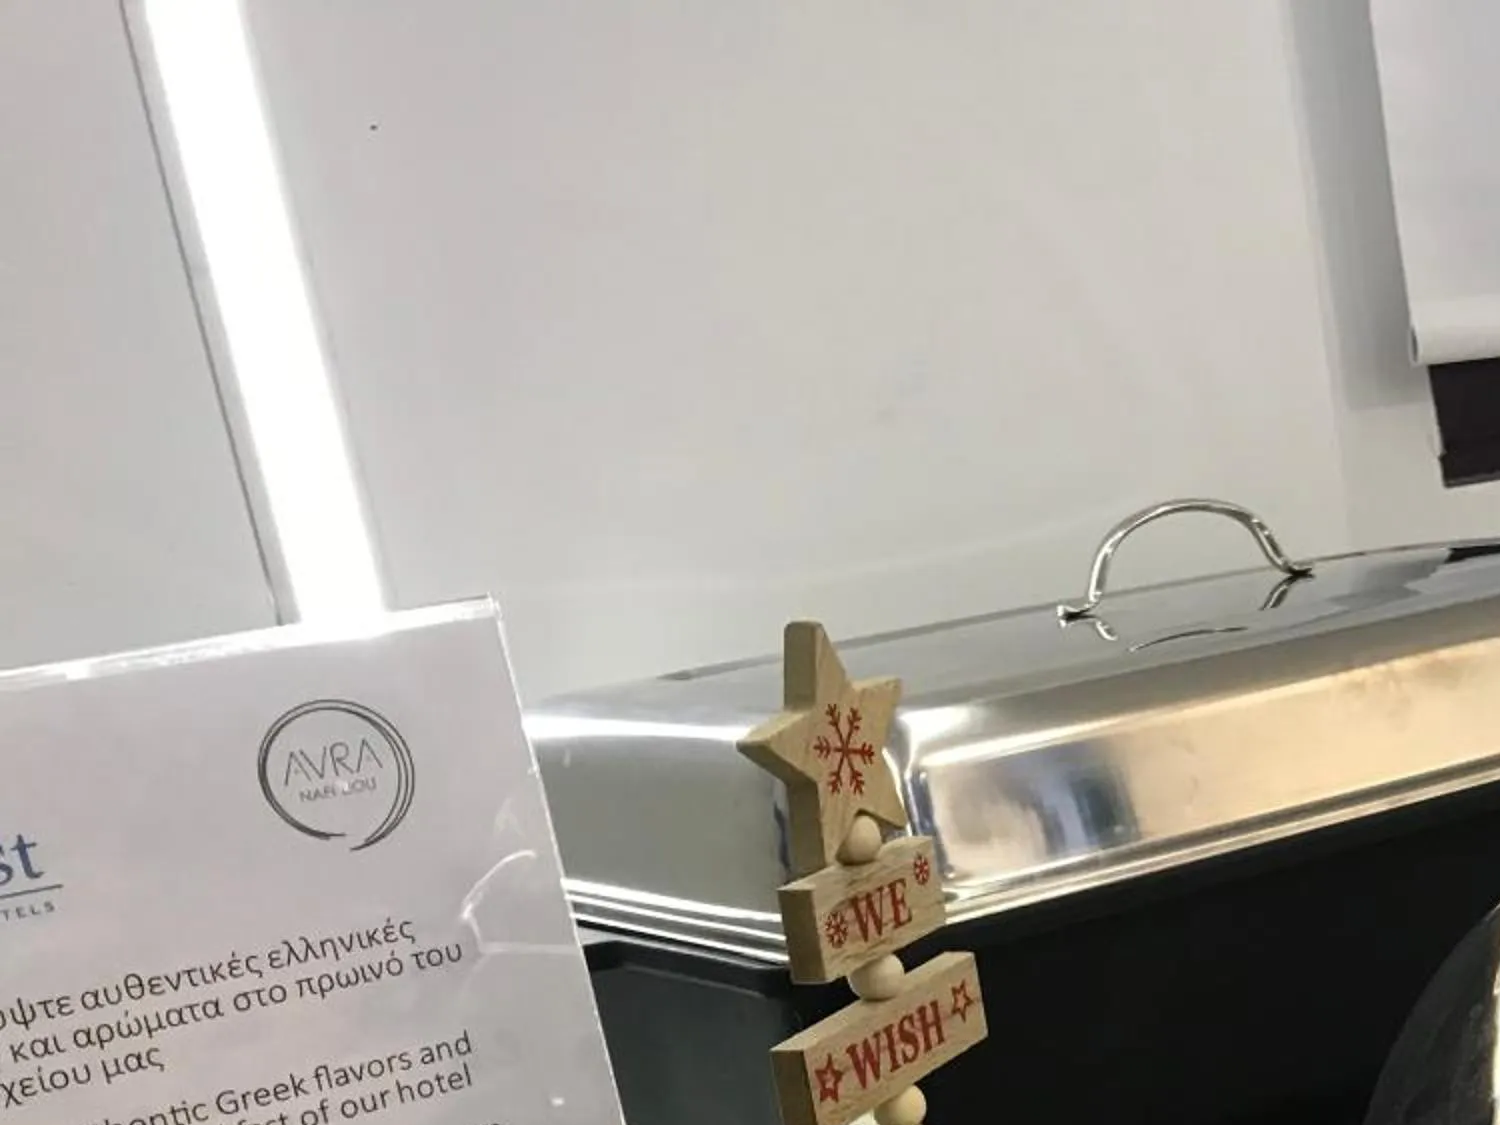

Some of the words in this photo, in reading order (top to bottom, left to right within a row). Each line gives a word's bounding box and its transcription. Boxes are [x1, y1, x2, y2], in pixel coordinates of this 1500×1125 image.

[284, 738, 383, 786] AVRA
[850, 878, 913, 942] WE
[81, 951, 264, 1011] αυθεντικές
[268, 917, 416, 969] ελληνικές
[10, 1034, 67, 1063] και
[73, 999, 225, 1050] αρώματα
[233, 984, 287, 1012] στο
[295, 949, 403, 999] πρωινό
[409, 943, 463, 971] του
[101, 1046, 165, 1085] μας
[215, 1073, 310, 1115] Greek
[313, 1050, 413, 1092] flavors
[420, 1029, 473, 1066] and
[846, 1001, 945, 1090] WISH
[340, 1088, 391, 1120] our
[395, 1062, 473, 1104] hotel
